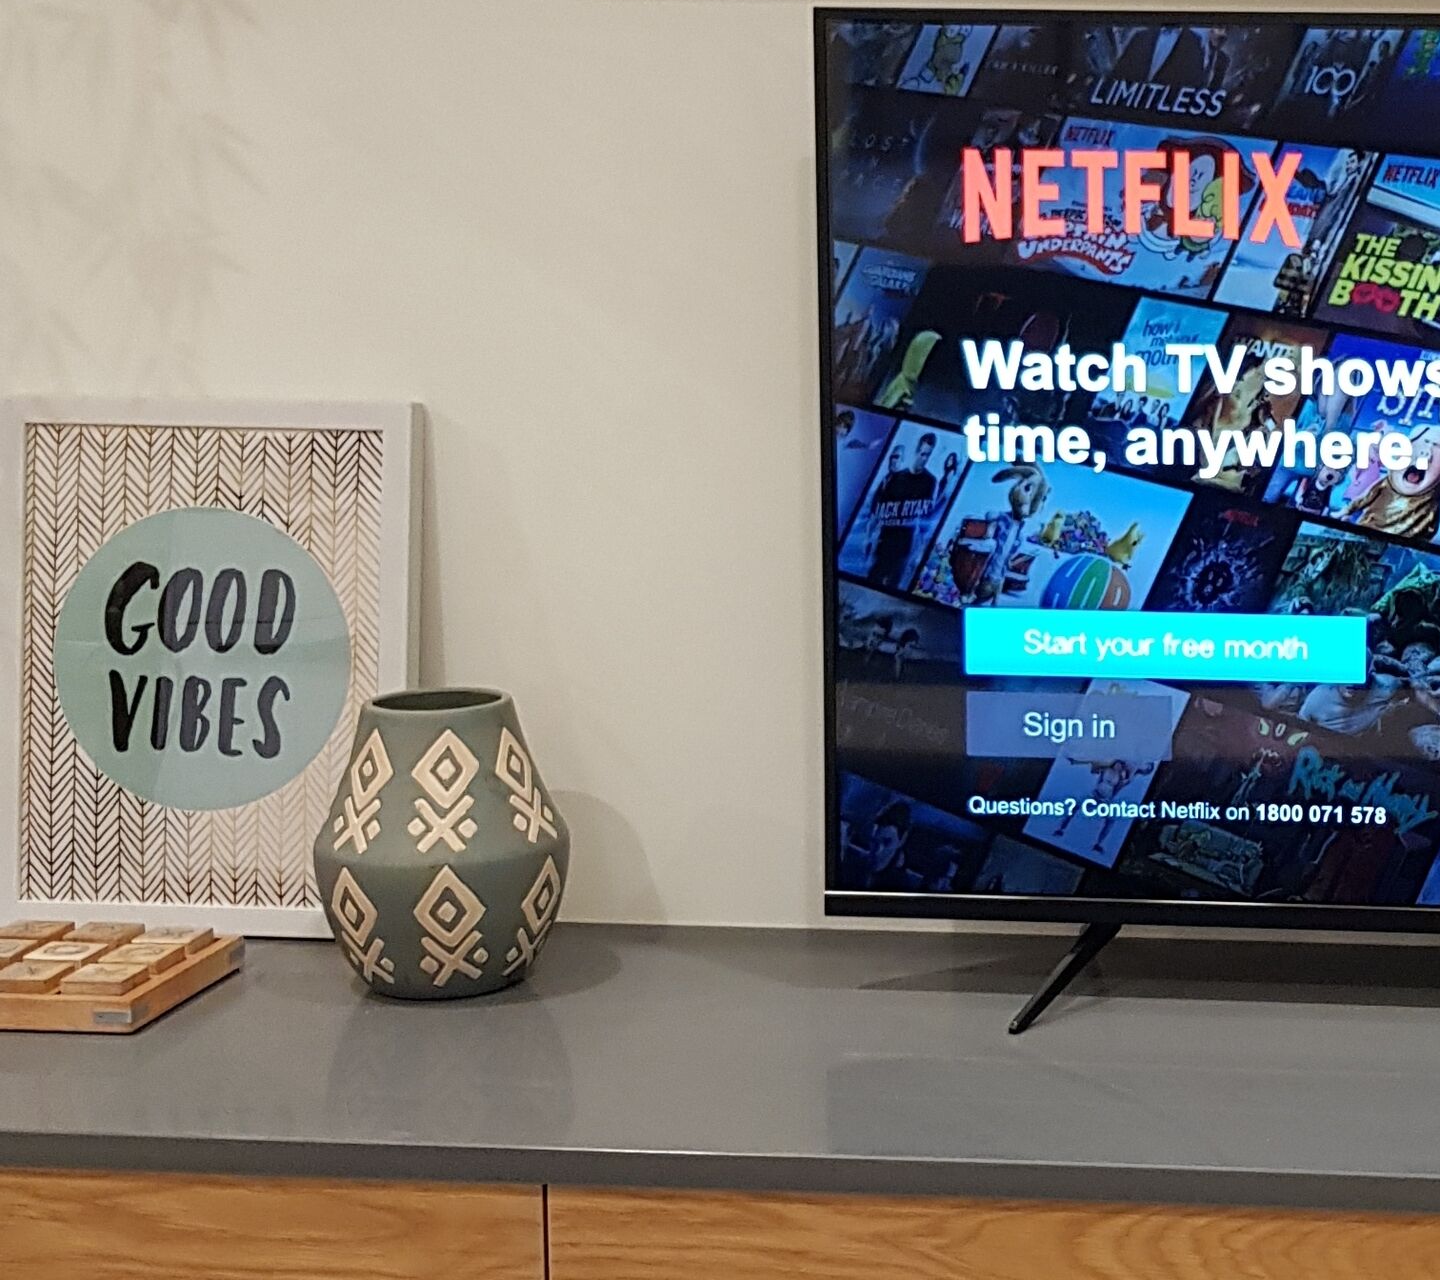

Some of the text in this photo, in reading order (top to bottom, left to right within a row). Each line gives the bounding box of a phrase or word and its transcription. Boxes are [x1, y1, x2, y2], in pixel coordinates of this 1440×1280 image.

[1090, 77, 1227, 118] LIMITLESS
[961, 147, 1303, 249] NETFLIX
[1355, 233, 1402, 259] THE
[961, 339, 1147, 393] Watch
[1164, 343, 1248, 395] TV
[962, 412, 1430, 480] time, anywhere.
[103, 561, 297, 657] GOOD
[1022, 628, 1309, 663] Start your free month
[107, 668, 291, 759] VIBES
[1022, 712, 1117, 745] Sign in
[967, 796, 1387, 825] Questions? Contact Netflix on 1800 071 578
